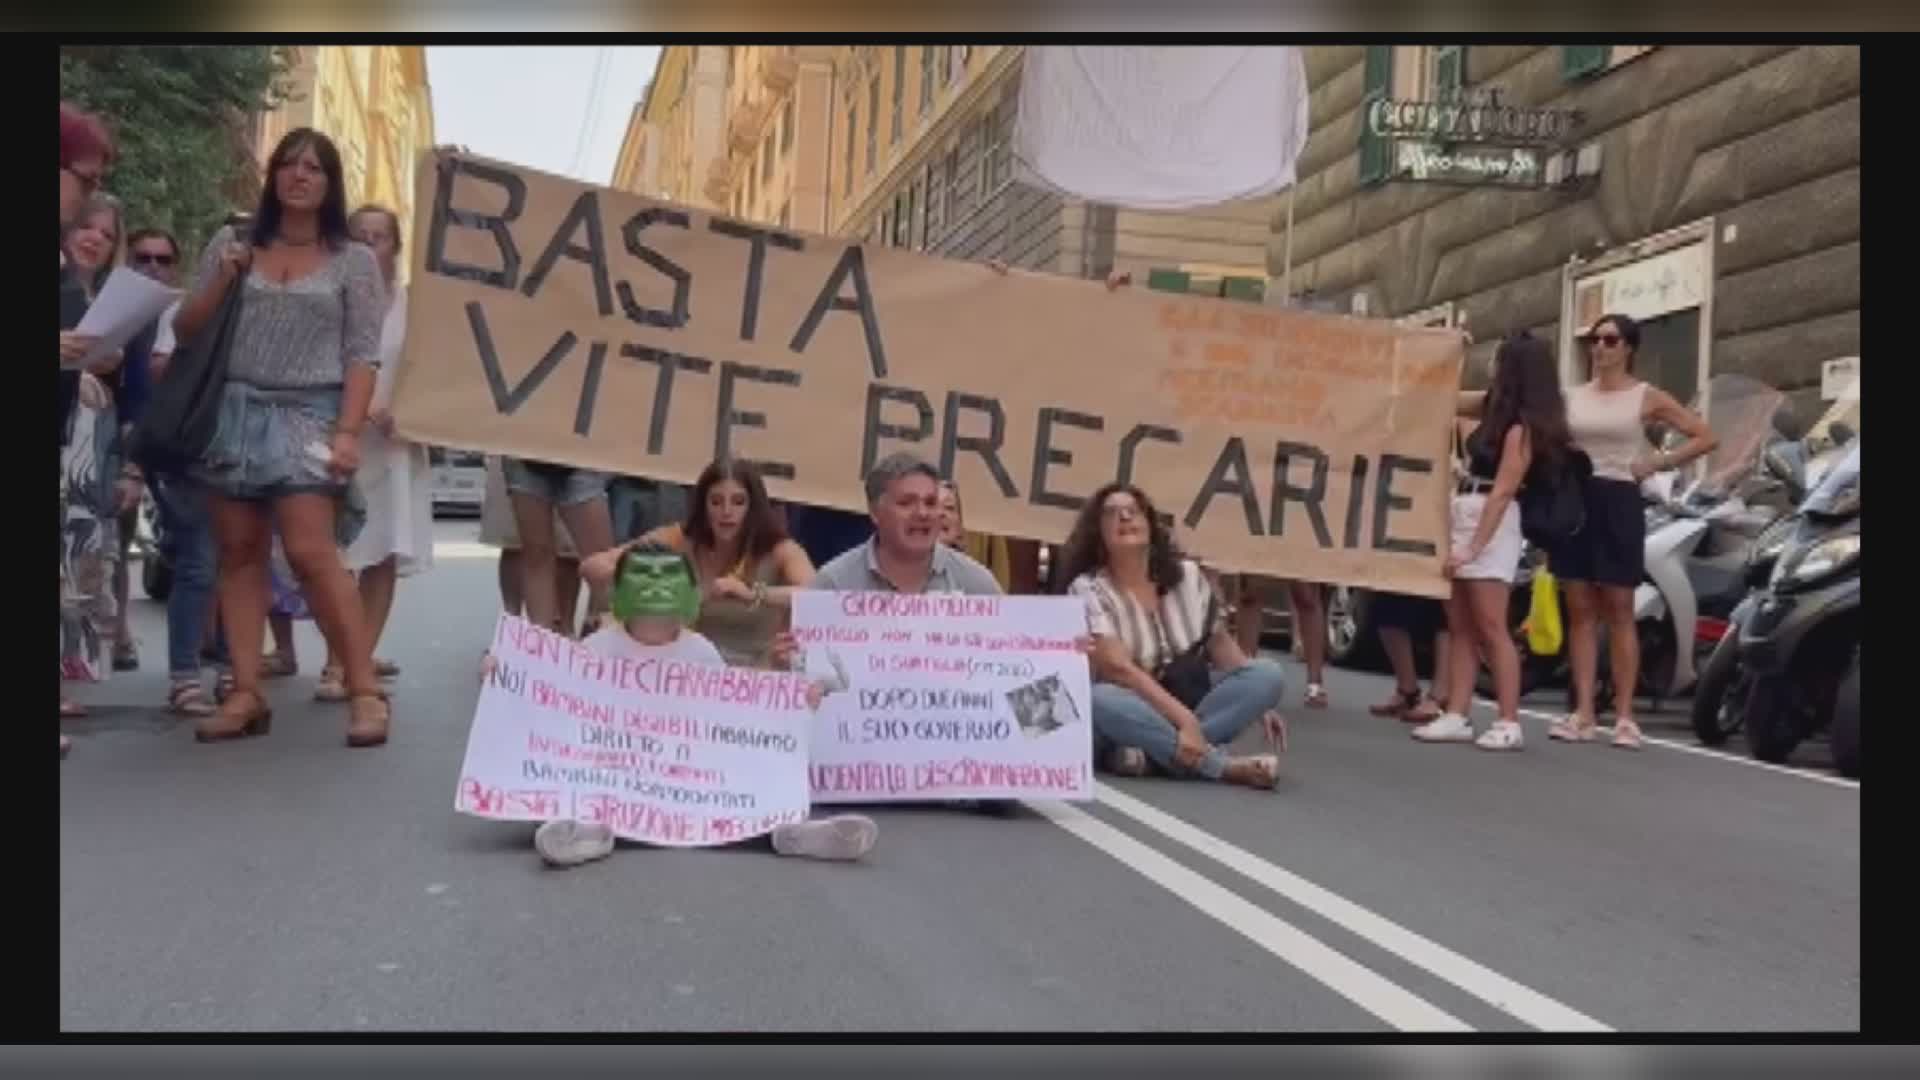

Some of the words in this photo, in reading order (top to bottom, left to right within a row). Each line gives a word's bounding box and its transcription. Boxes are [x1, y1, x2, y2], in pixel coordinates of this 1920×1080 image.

[426, 159, 887, 378] BASTA
[465, 301, 801, 480] VITE
[860, 382, 1437, 556] PRECARIE
[859, 688, 917, 711] DOPO
[921, 689, 951, 711] DUE
[952, 690, 993, 711] ANNI
[861, 719, 909, 743] SUO
[912, 719, 1011, 742] GOVERNO
